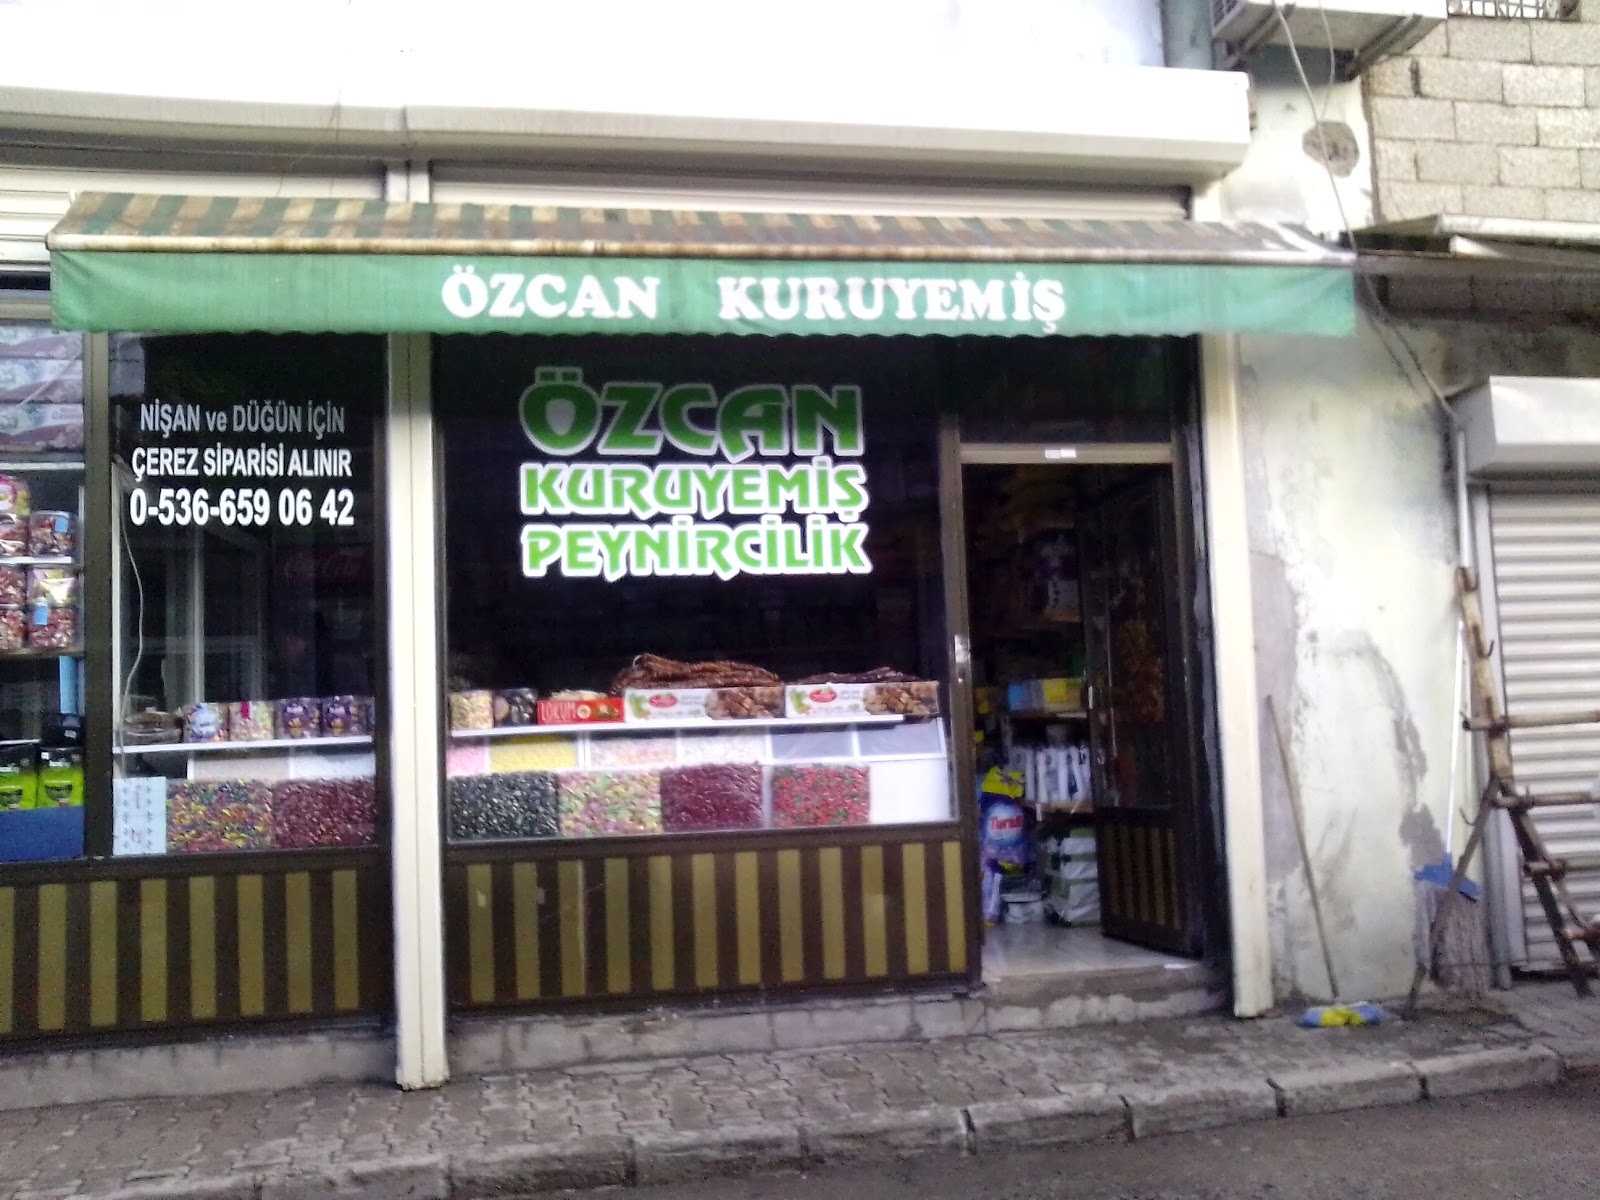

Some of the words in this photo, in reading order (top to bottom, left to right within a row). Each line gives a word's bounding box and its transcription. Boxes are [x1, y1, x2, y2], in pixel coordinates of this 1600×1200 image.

[441, 264, 661, 319] ÖZCAN
[717, 272, 1066, 334] KURUYEMİŞ
[140, 398, 201, 438] NİŞAN
[206, 411, 228, 432] ve
[233, 399, 302, 433] DÜĞÜN
[307, 400, 345, 440] İÇİN
[518, 366, 866, 463] ÖZCAN
[132, 447, 199, 482] ÇEREZ
[203, 442, 284, 477] SİPARİSİ
[287, 449, 353, 477] ALINIR
[520, 456, 869, 522] KURUYEMİŞ
[130, 488, 271, 526] 0-536-659
[278, 488, 313, 526] 06
[320, 488, 355, 526] 42
[521, 514, 873, 581] PEYNİRCİLİK
[539, 701, 577, 721] LOKUM
